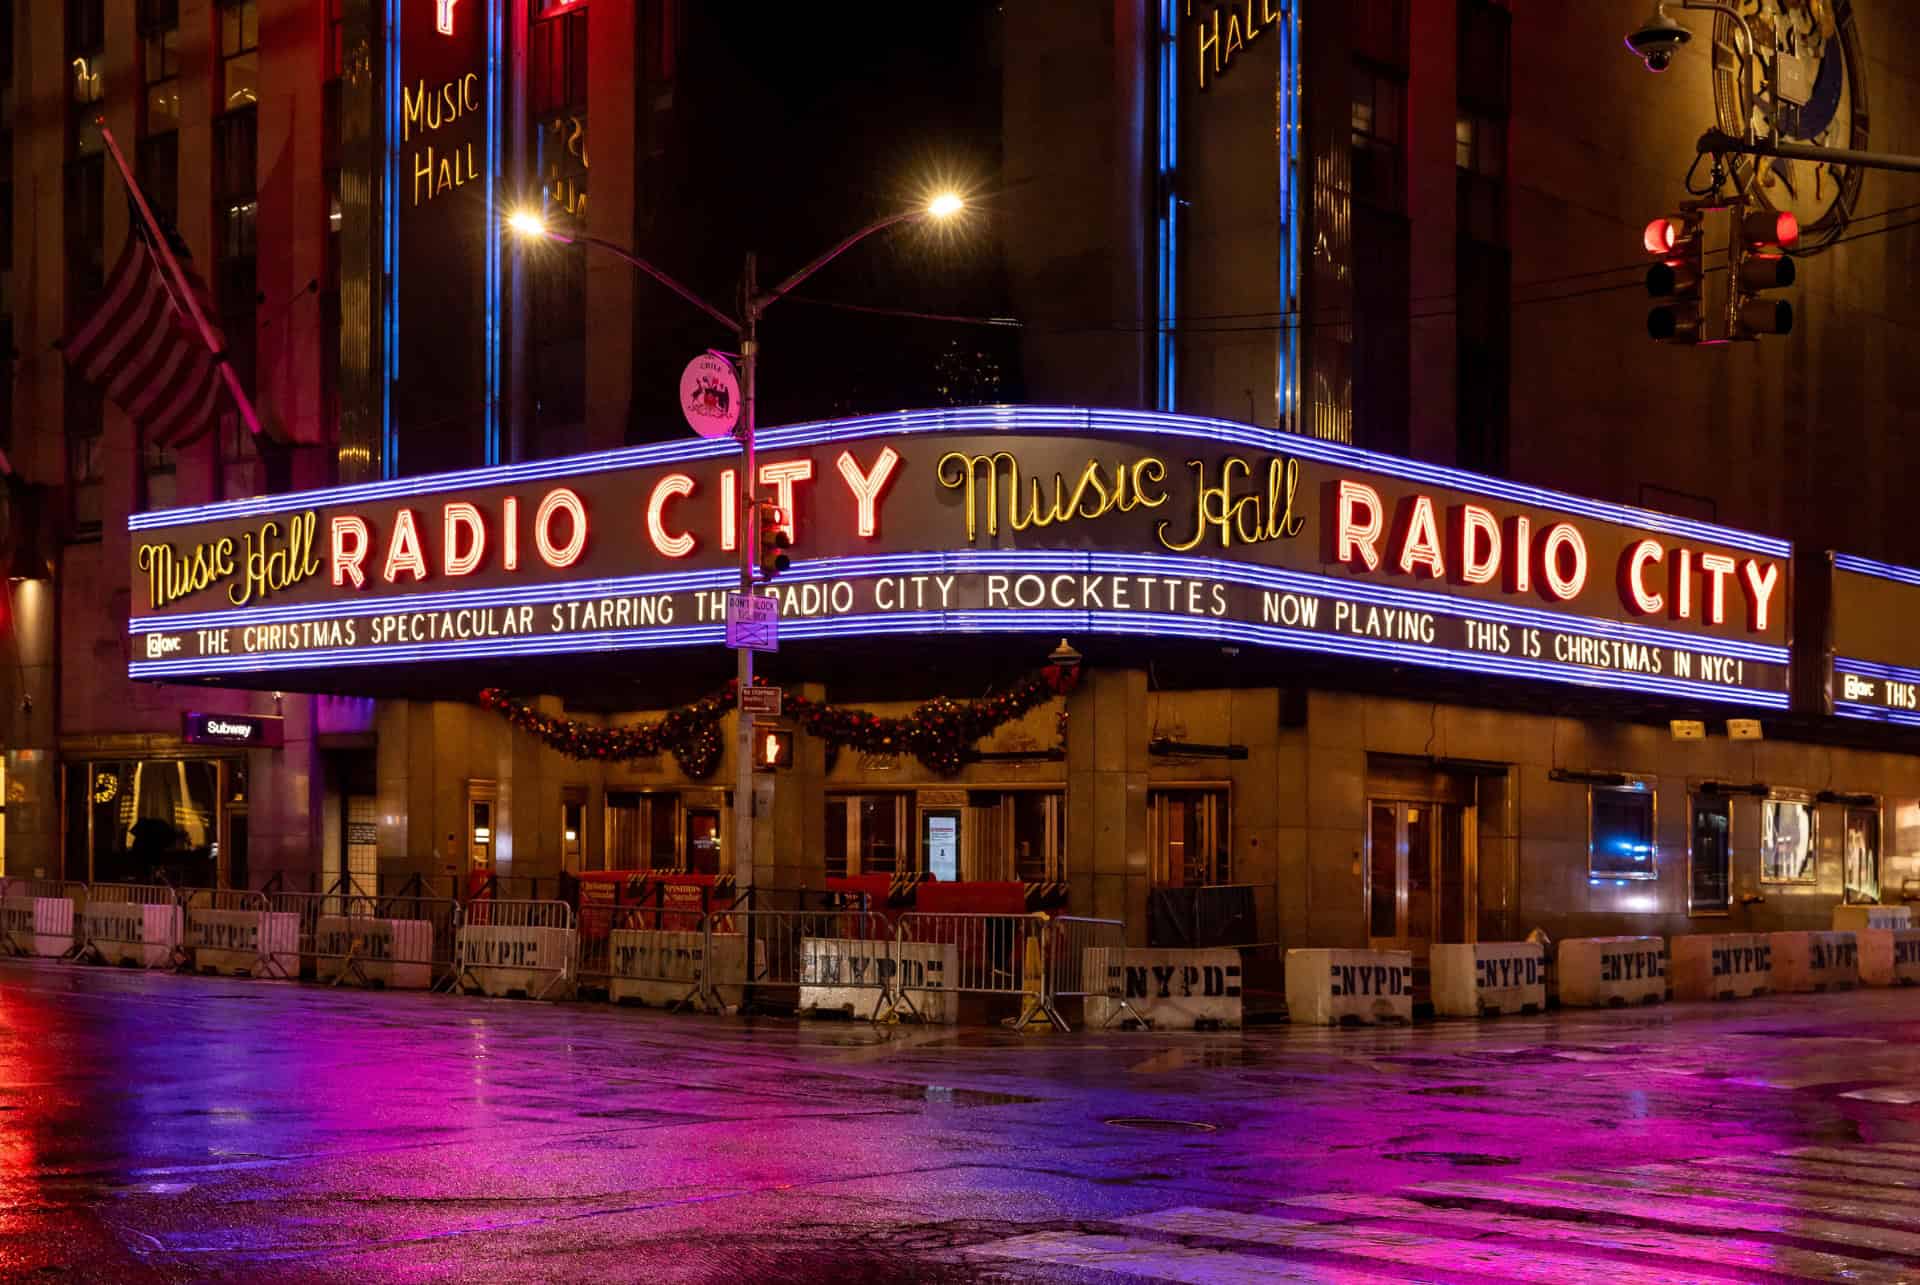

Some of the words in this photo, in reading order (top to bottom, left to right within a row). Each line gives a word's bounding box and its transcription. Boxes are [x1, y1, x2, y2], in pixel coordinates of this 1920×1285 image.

[404, 73, 478, 142] MUSIC
[414, 143, 478, 206] HALL
[331, 487, 588, 588] RADIO
[647, 446, 899, 557] CITY
[939, 452, 1168, 542] Music
[1158, 457, 1304, 551] Hall
[139, 543, 233, 608] Music
[228, 511, 319, 606] Hall
[1337, 479, 1588, 600] RADIO
[1630, 539, 1778, 630] CITY
[197, 629, 230, 655] THE
[243, 618, 356, 653] CHRISTMAS
[371, 606, 534, 645] SPECTACULAR
[551, 595, 673, 632] STARRING
[694, 590, 741, 621] TH
[875, 576, 955, 610] CITY
[987, 574, 1226, 616] ROCKETTES
[1263, 591, 1319, 628] NOW
[1335, 601, 1434, 643] PLAYING
[1465, 619, 1511, 654] THIS
[1523, 627, 1541, 657] IS
[1554, 634, 1662, 674] CHRISTMAS
[1673, 650, 1691, 678] IN
[1700, 654, 1744, 685] NYC!
[1884, 681, 1917, 709] THIS
[207, 720, 252, 738] Subway
[1125, 965, 1225, 998] NYPD
[1342, 966, 1401, 996] NYPD
[1486, 958, 1538, 988] NYPD
[1610, 951, 1658, 981] NYPD
[1720, 947, 1765, 976] NYPD
